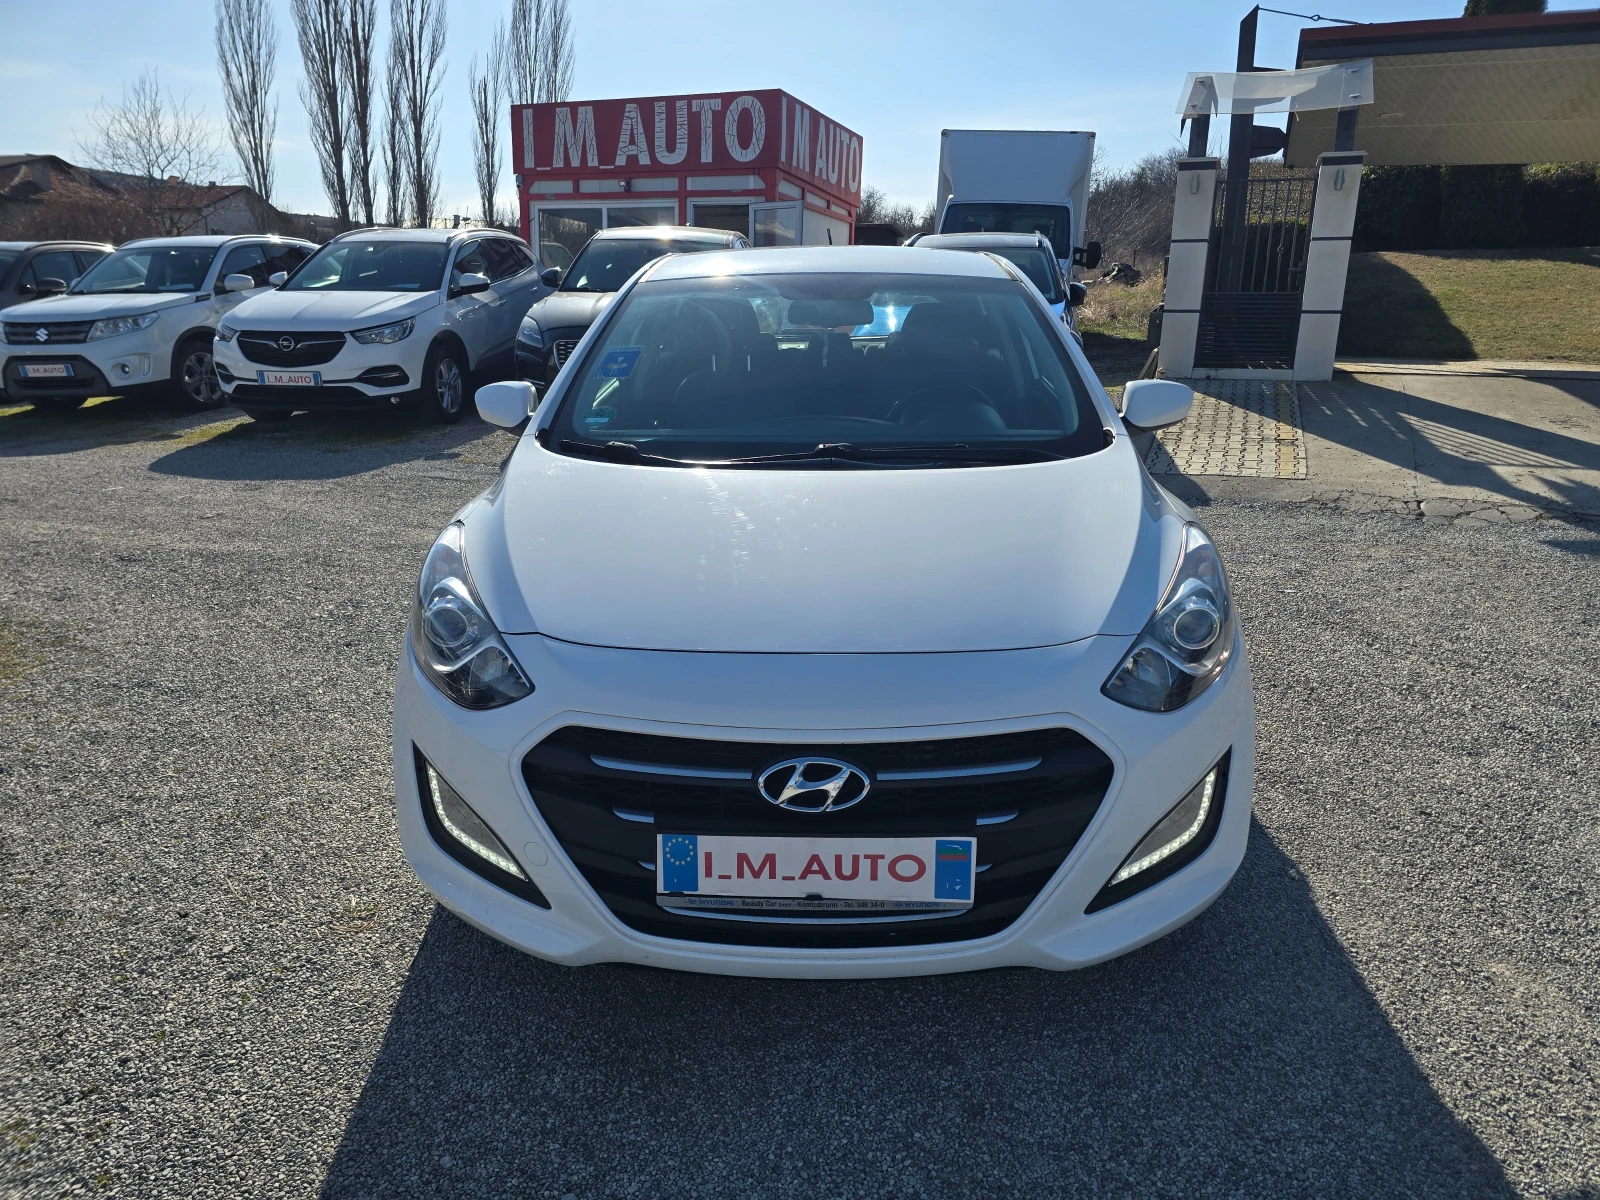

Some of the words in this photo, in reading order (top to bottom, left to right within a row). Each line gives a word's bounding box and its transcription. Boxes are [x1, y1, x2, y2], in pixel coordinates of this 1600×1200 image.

[522, 95, 766, 171] I_M_AUTO
[780, 96, 788, 163] I
[792, 103, 810, 173] M
[815, 117, 860, 193] AUTO
[266, 373, 312, 384] I_M_AUTO
[704, 851, 927, 882] I_M_AUTO
[741, 900, 764, 908] Beauty
